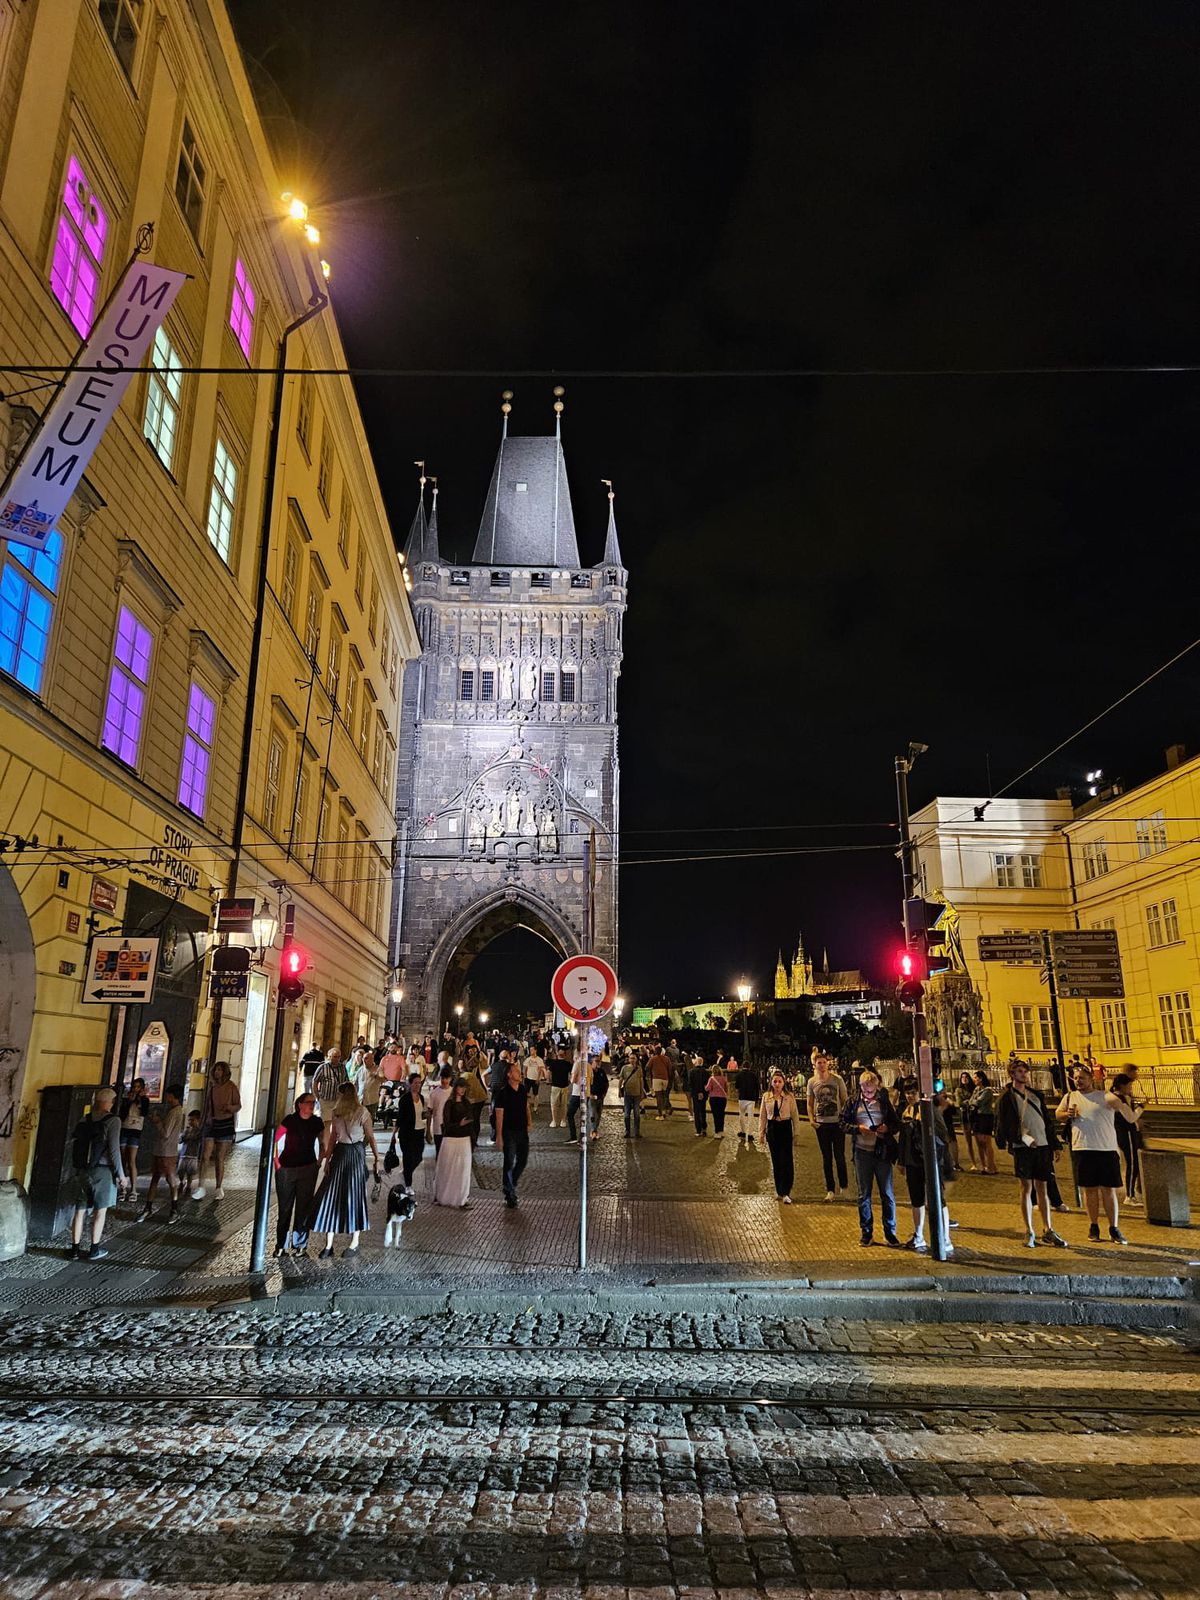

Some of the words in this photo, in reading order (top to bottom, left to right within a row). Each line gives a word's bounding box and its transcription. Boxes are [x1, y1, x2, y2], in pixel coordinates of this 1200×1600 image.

[32, 275, 171, 486] MUSEUM
[164, 824, 193, 857] STORY
[150, 846, 164, 869] OF
[164, 854, 199, 887] PRAGUE
[220, 977, 238, 985] WC
